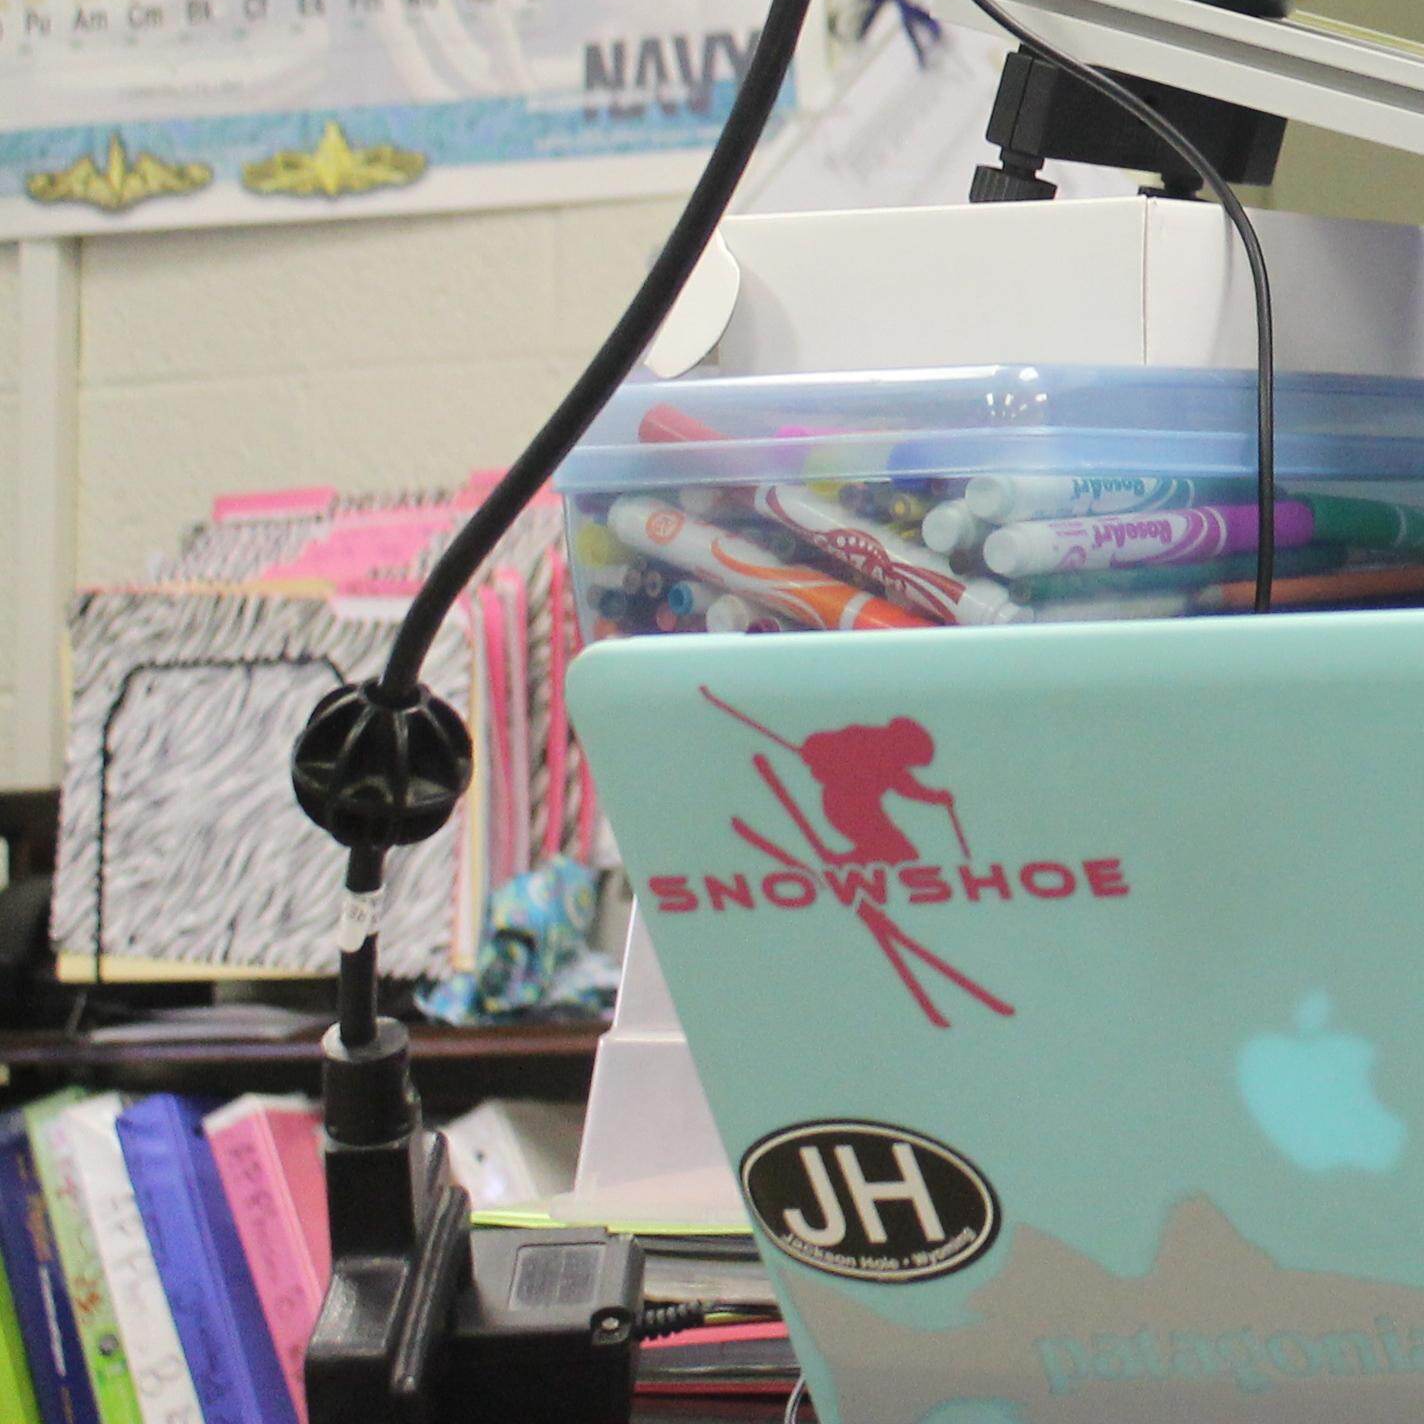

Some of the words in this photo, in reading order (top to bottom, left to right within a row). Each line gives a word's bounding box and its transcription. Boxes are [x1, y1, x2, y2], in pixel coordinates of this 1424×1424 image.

[584, 30, 766, 119] NAVY
[1092, 520, 1172, 548] RoseArt
[647, 857, 1131, 914] SNOWSHOE
[784, 1142, 945, 1245] JH
